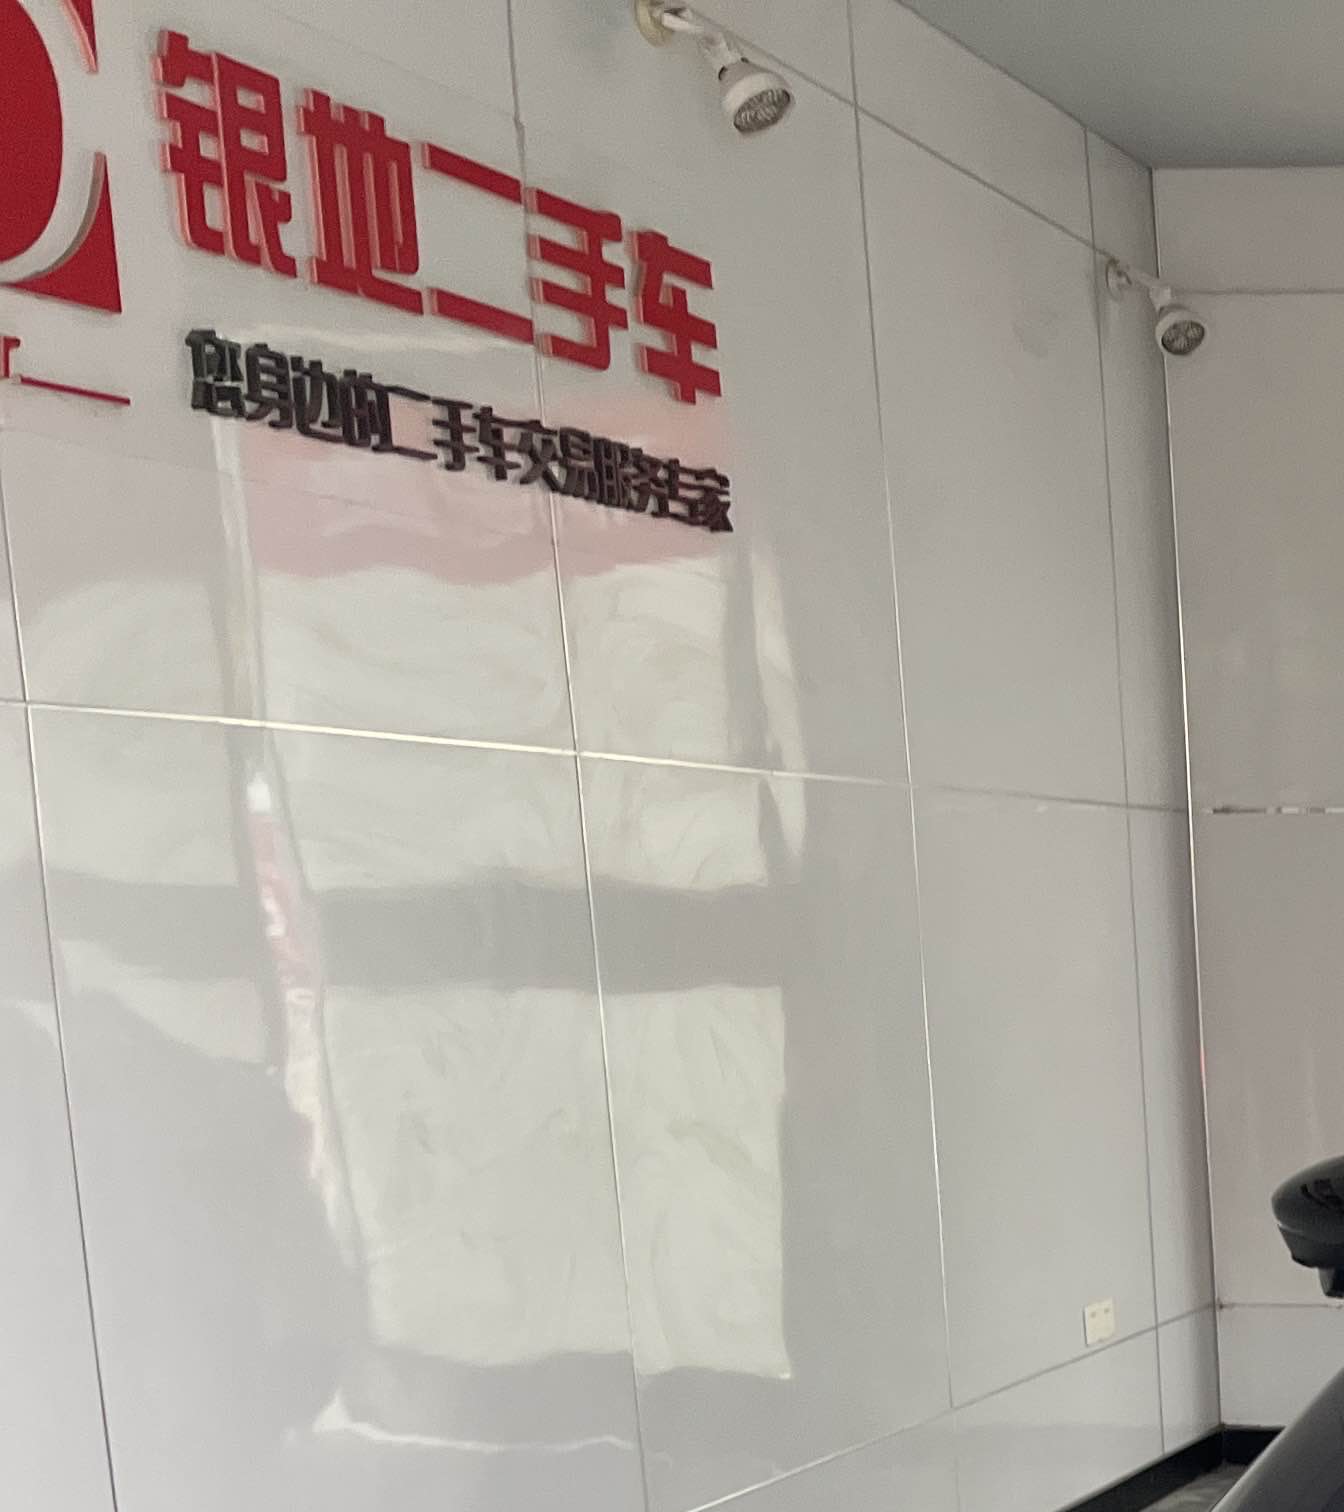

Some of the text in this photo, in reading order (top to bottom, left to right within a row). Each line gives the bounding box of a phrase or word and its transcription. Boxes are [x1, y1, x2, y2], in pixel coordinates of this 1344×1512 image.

[154, 28, 722, 405] 银地二手车
[186, 328, 734, 533] 您身边的二手车交易服务专家
